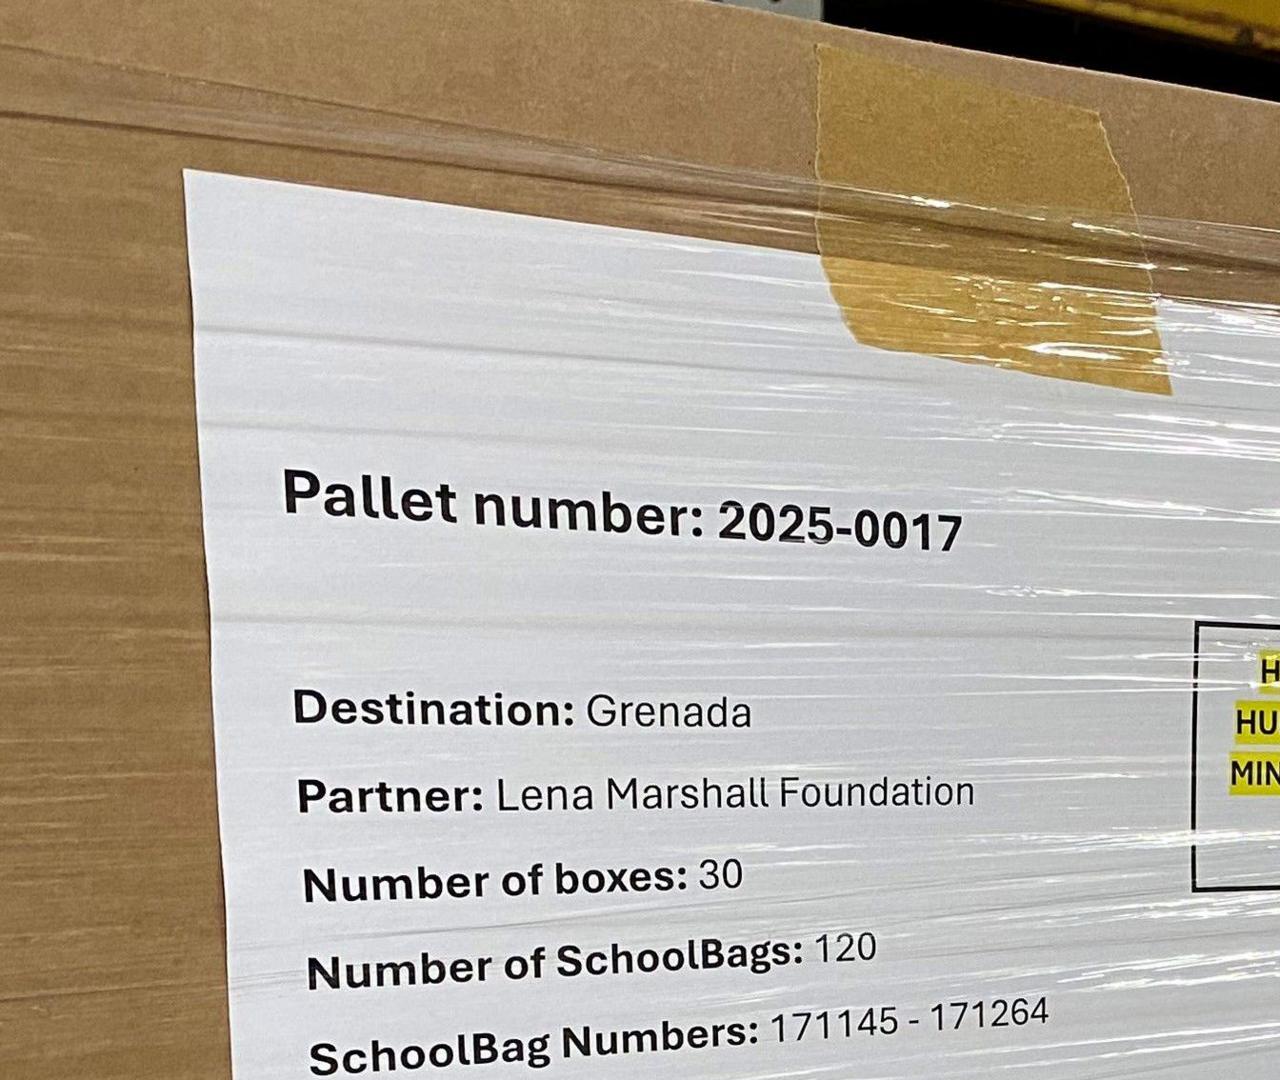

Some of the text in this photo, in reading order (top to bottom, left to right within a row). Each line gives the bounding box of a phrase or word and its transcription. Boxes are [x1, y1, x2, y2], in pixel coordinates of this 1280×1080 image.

[283, 468, 963, 553] Pallet number: 2025-0017
[293, 688, 752, 729] Destination: Grenada
[298, 775, 976, 813] Partner: Lena Marshall Foundation
[304, 858, 744, 903] Number of boxes: 30
[308, 931, 877, 991] Number of SchoolBags: 120
[309, 1029, 551, 1077] SchoolBag
[561, 1015, 759, 1061] Numbers:
[771, 1005, 899, 1043] 171145
[931, 996, 1050, 1031] 171264
